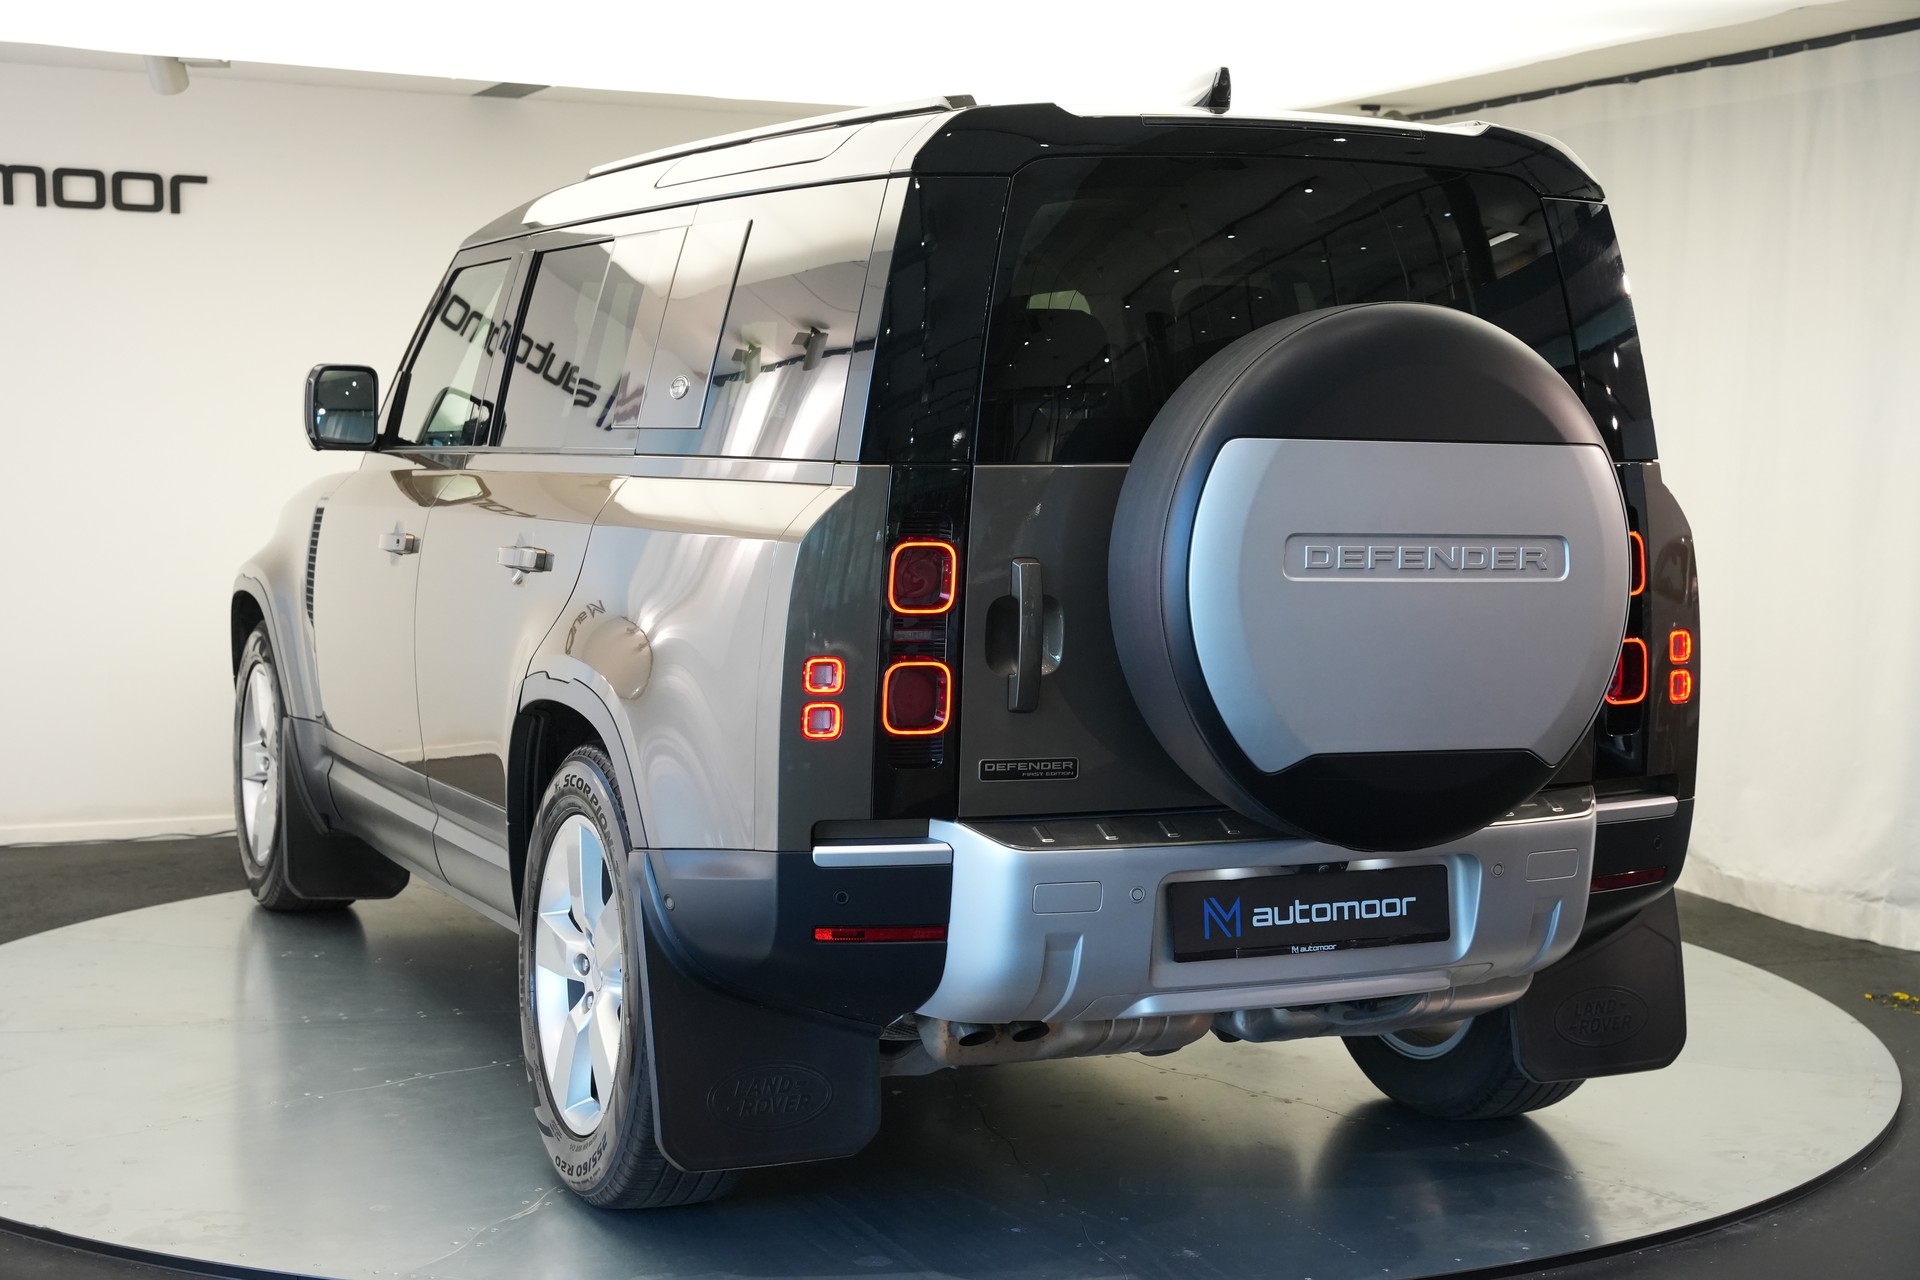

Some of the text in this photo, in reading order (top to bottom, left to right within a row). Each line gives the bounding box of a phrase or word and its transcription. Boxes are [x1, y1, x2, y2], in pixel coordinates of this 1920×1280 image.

[1304, 545, 1548, 570] DEFENDER
[984, 761, 1074, 772] DEFENDER
[562, 774, 614, 849] SCORPION
[1252, 896, 1417, 928] automoor
[1300, 944, 1337, 953] automoor
[555, 1155, 574, 1177] R20
[575, 1131, 608, 1177] 255/60
